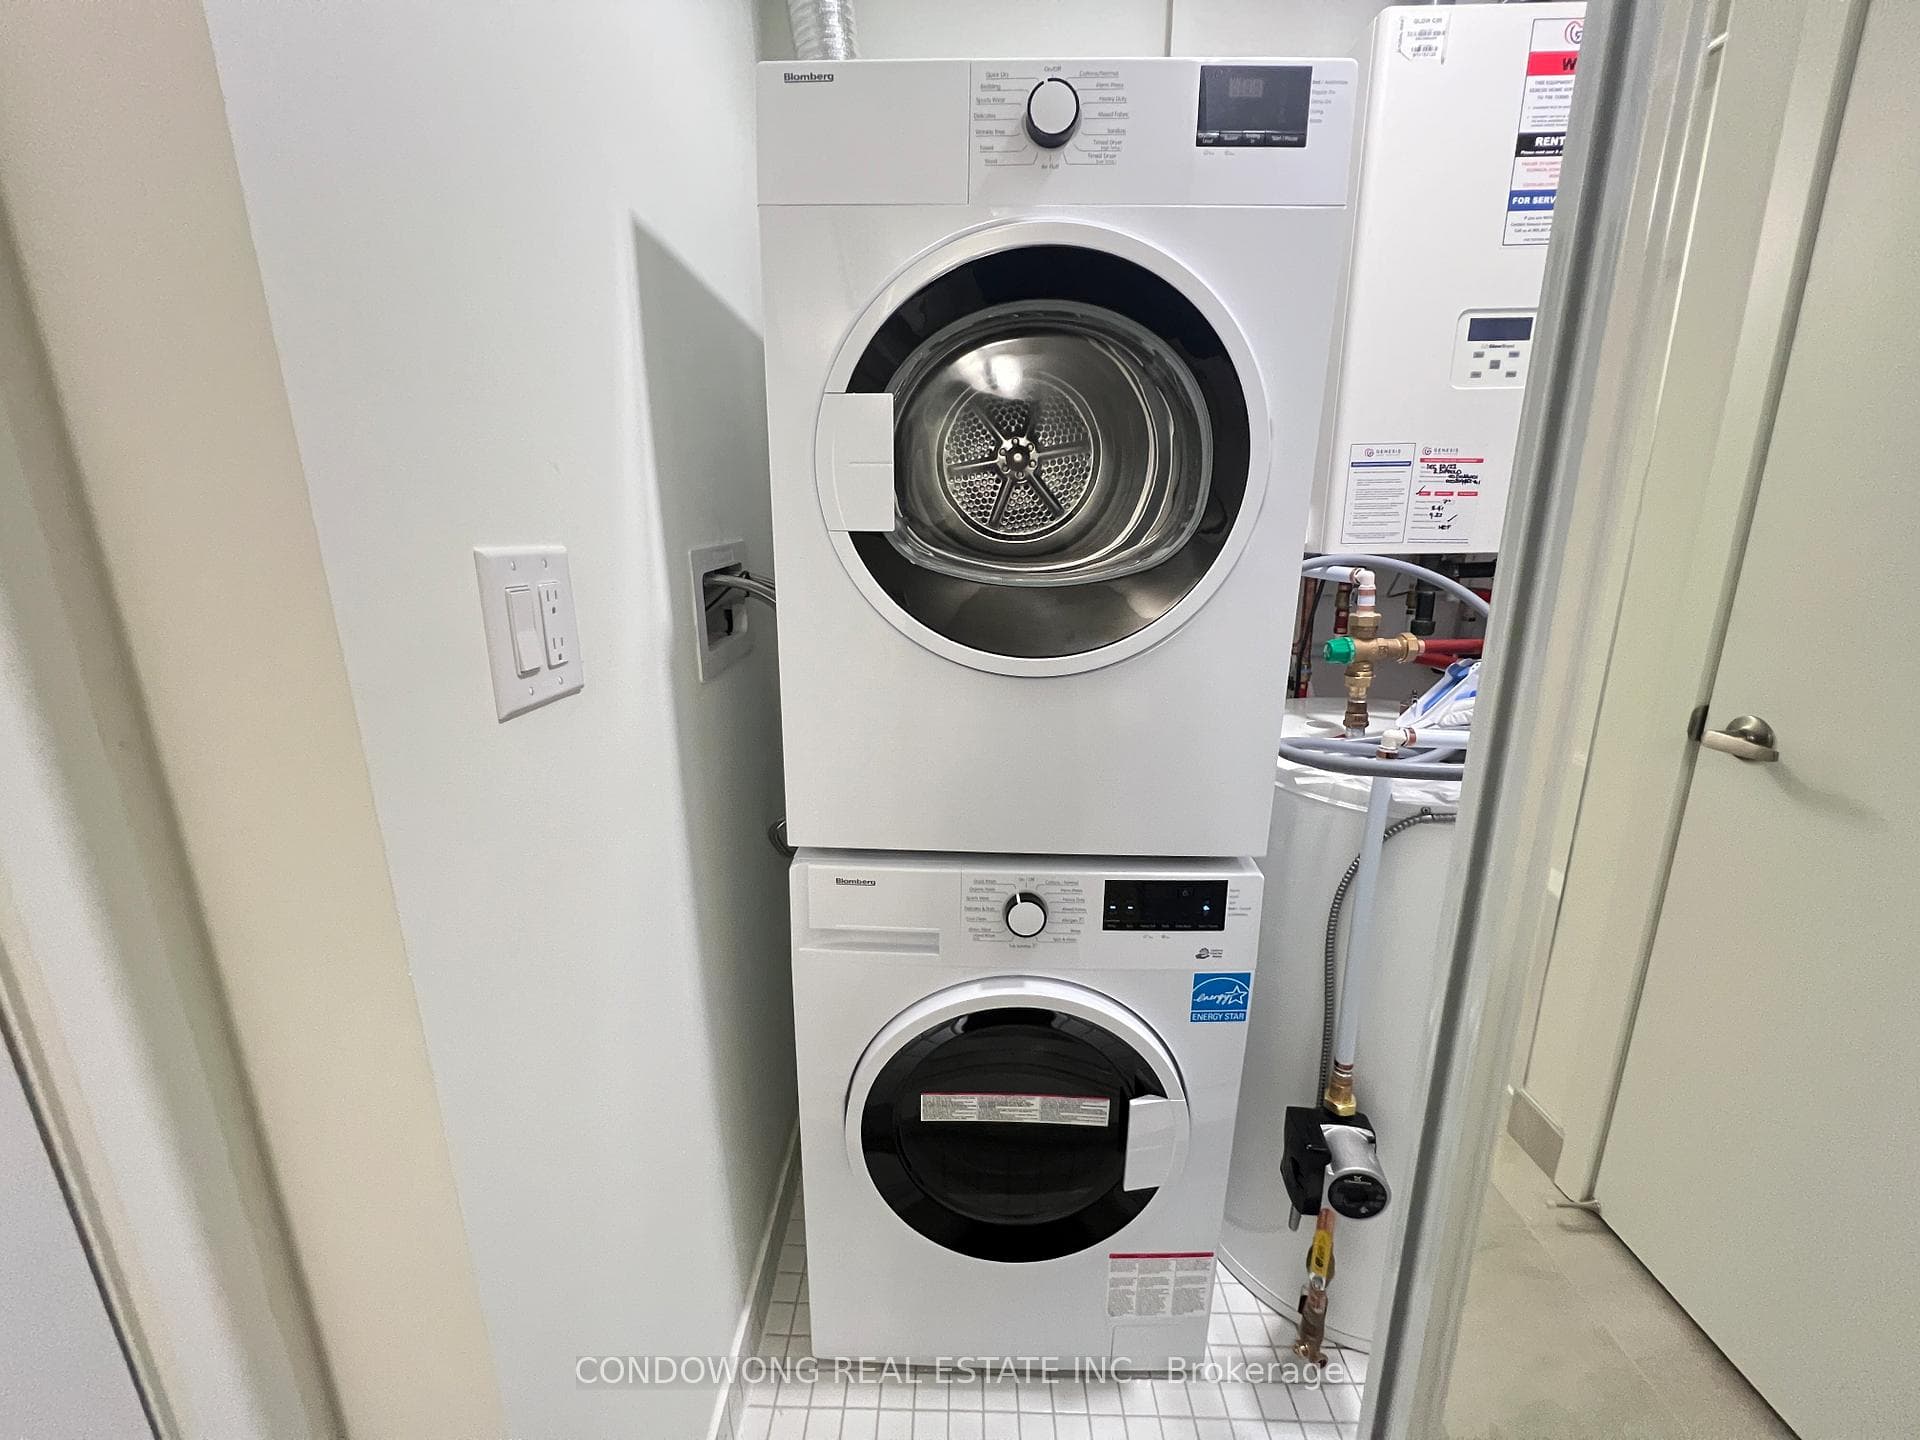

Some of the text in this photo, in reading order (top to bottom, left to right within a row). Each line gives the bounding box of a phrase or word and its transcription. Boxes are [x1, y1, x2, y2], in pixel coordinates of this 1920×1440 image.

[784, 72, 834, 83] Blomberg
[1512, 196, 1530, 204] FOR
[836, 878, 877, 887] Blomberg
[1192, 1013, 1223, 1021] ENERGY
